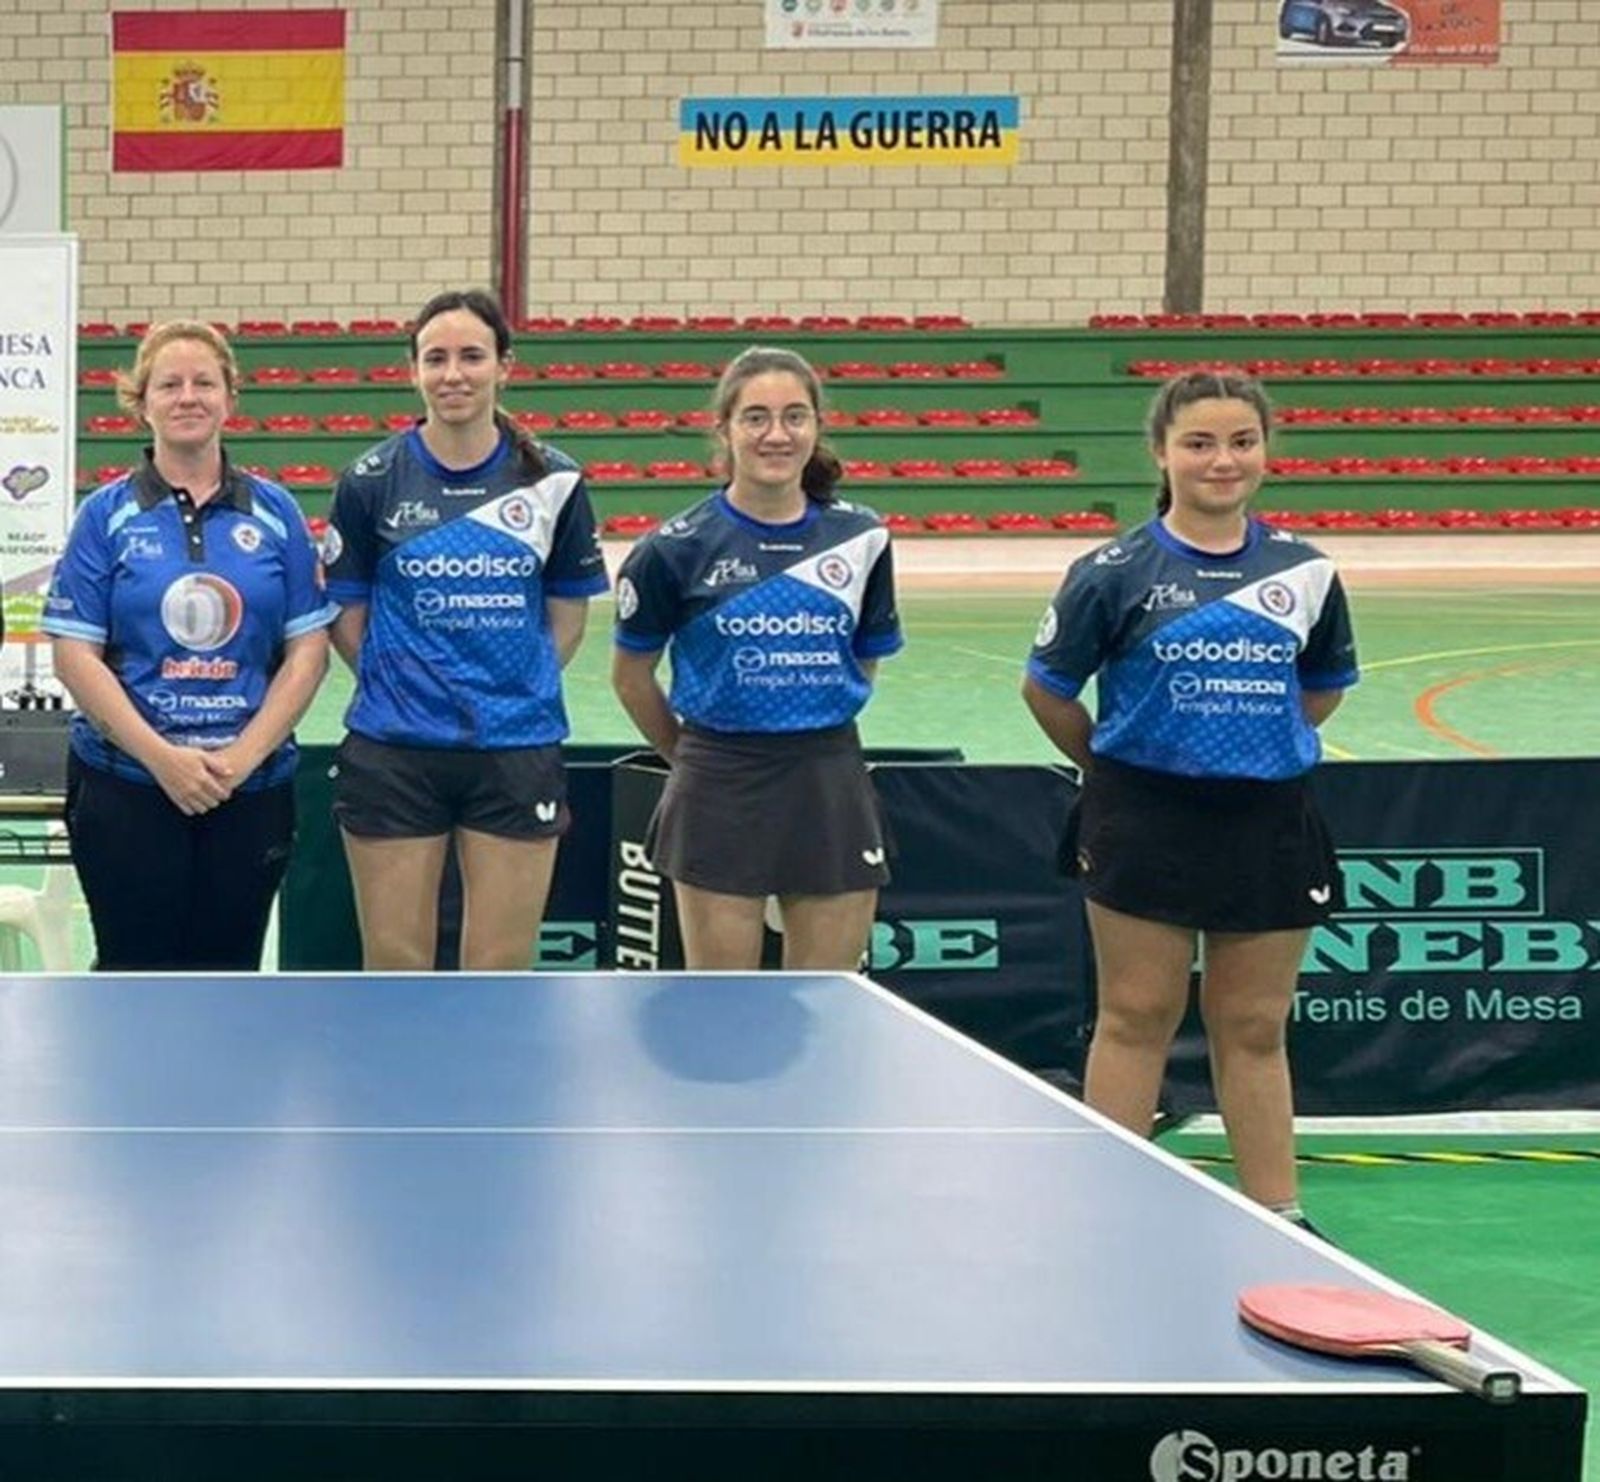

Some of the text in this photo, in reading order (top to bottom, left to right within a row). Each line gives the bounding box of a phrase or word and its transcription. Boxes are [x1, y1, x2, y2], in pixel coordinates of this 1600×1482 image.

[696, 109, 1002, 151] NO A LA GUERRA
[0, 334, 52, 355] ESA
[617, 841, 661, 972] BUTTE
[1191, 920, 1600, 972] NEB
[1293, 989, 1583, 1022] Tenis de Mesa
[1172, 1436, 1410, 1482] Sponeta
